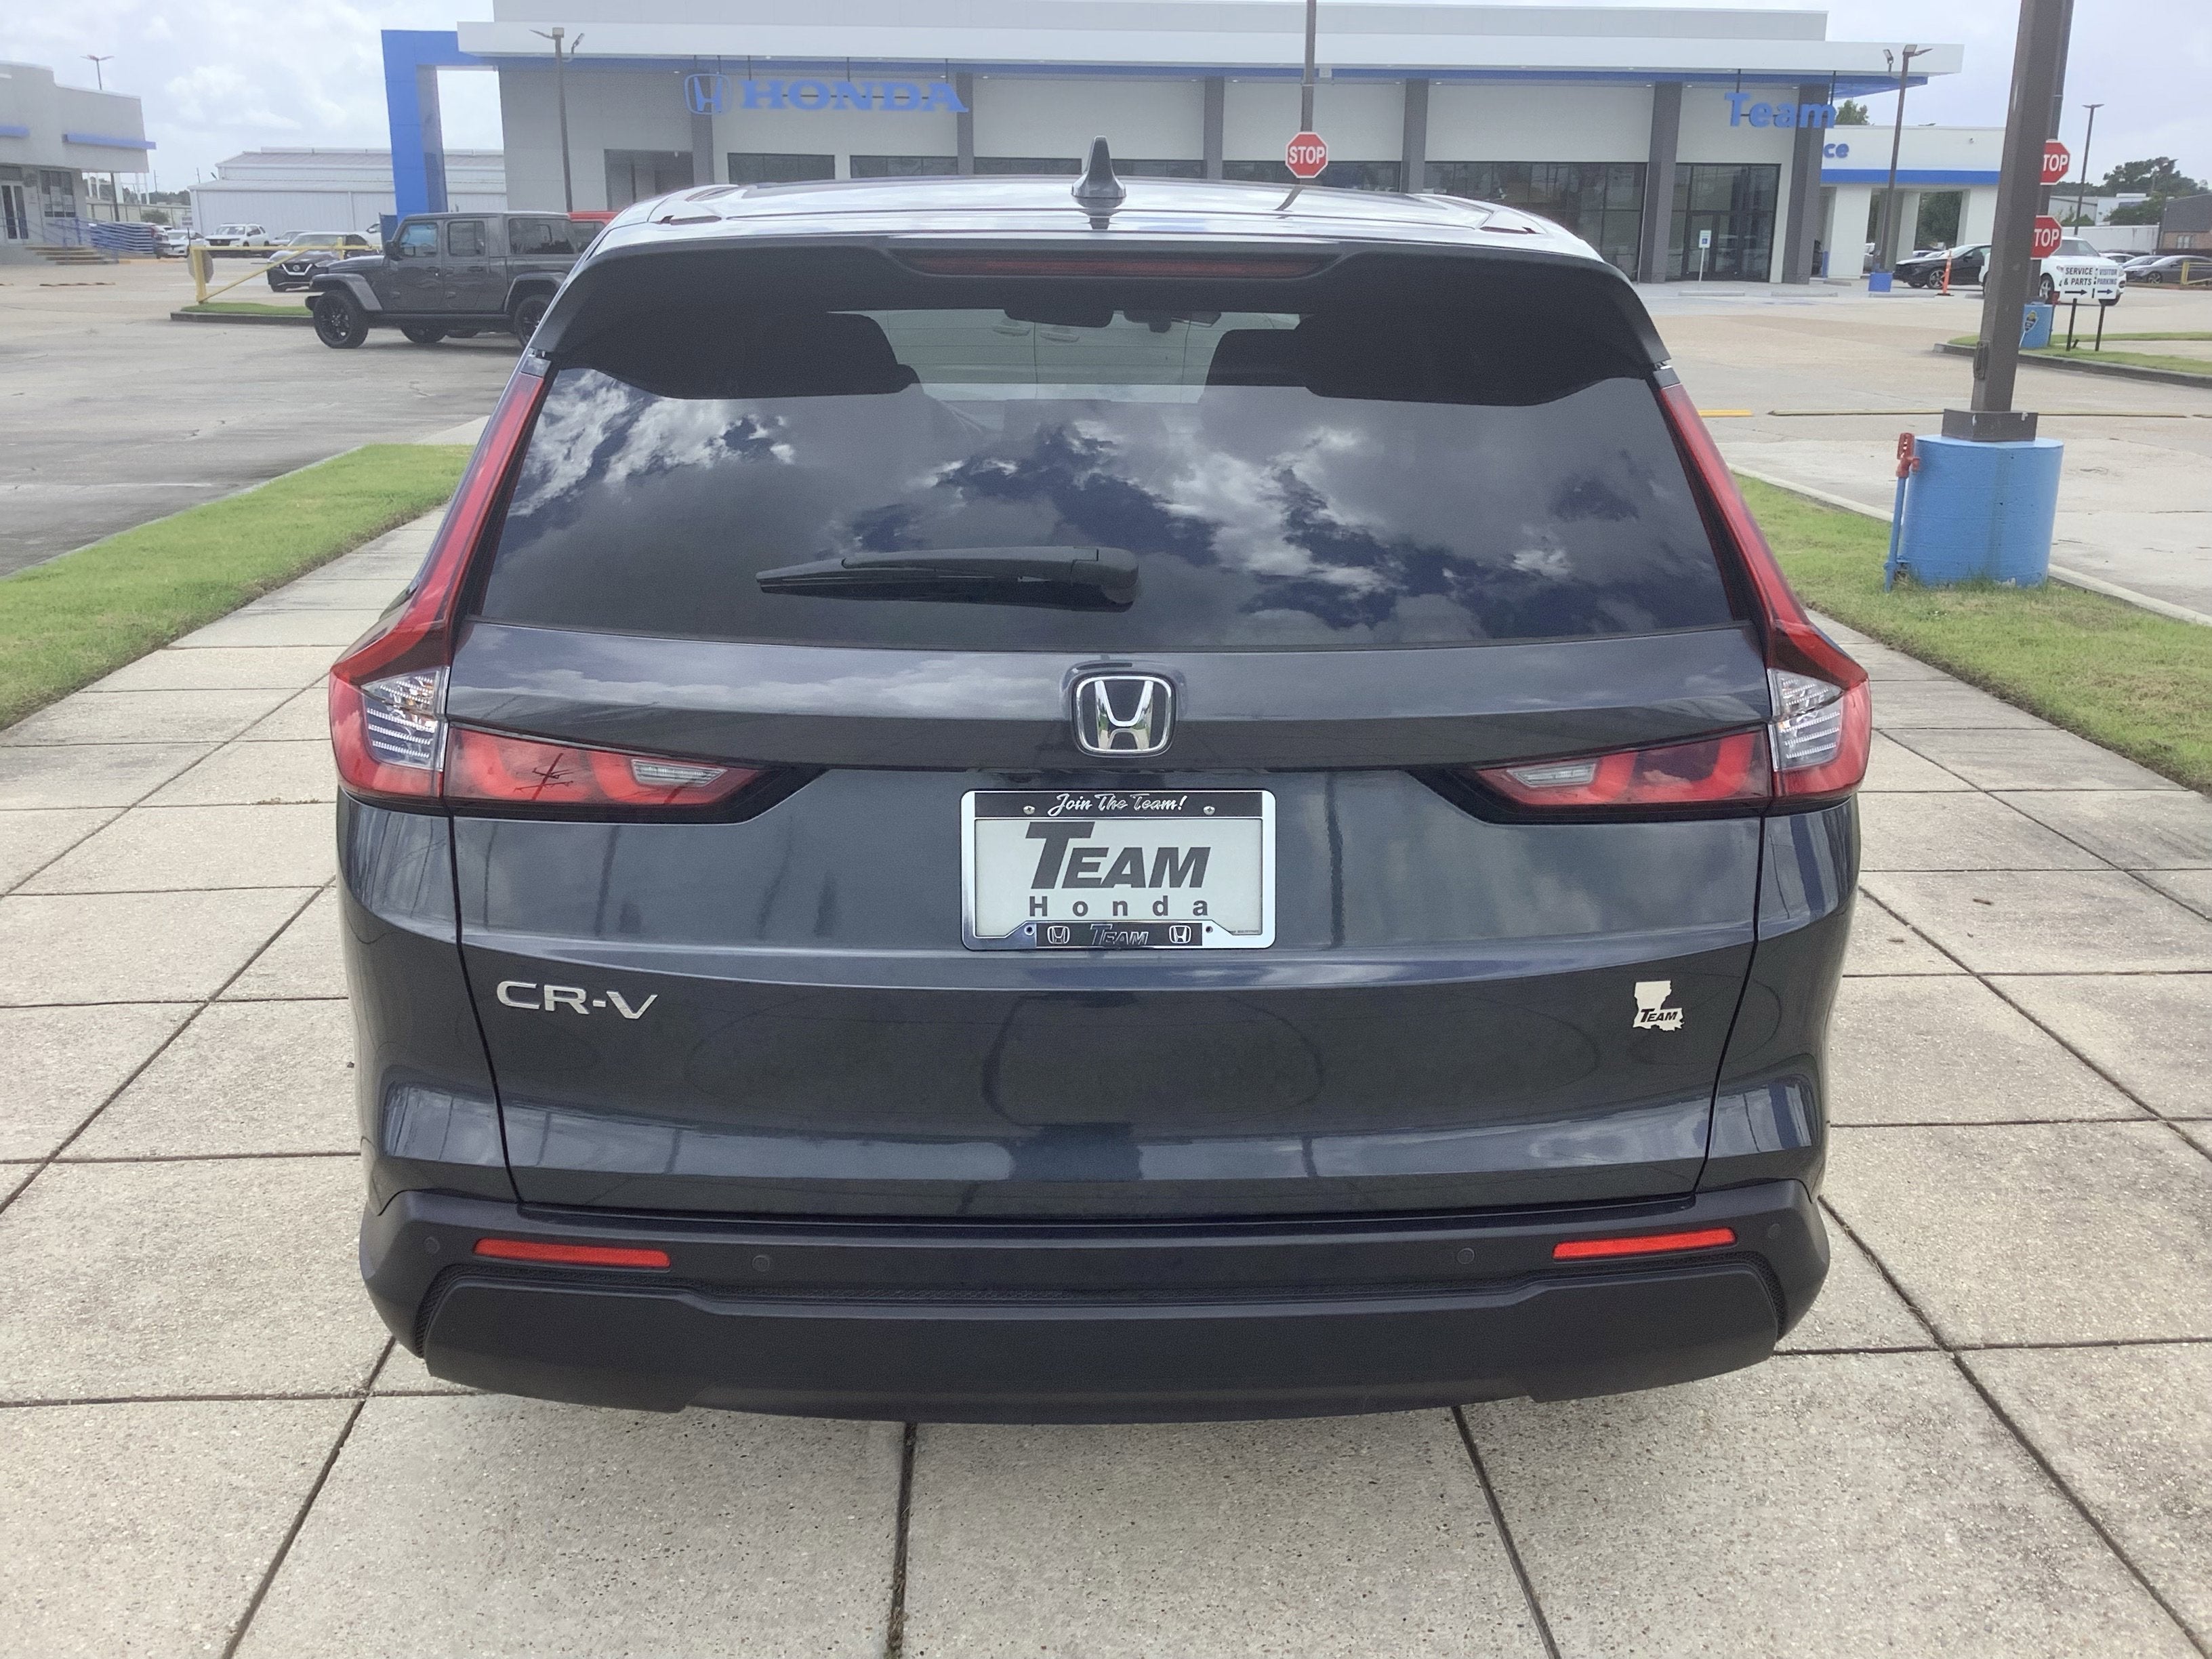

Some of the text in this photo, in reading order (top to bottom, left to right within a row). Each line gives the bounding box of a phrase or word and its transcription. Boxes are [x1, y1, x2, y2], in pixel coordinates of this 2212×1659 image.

[739, 79, 969, 112] HONDA
[1725, 92, 1837, 129] Team
[1288, 146, 1326, 165] STOP
[1824, 143, 1849, 159] ce
[2043, 154, 2068, 171] TOP
[2034, 228, 2060, 247] TOP
[2065, 267, 2093, 275] SERVICE
[1047, 793, 1188, 817] Join The Team!
[1025, 821, 1211, 889] TEAM
[1029, 895, 1209, 917] Honda
[1090, 924, 1149, 945] TEAM
[496, 981, 658, 1019] CR-V
[1640, 1008, 1679, 1023] TEAM
